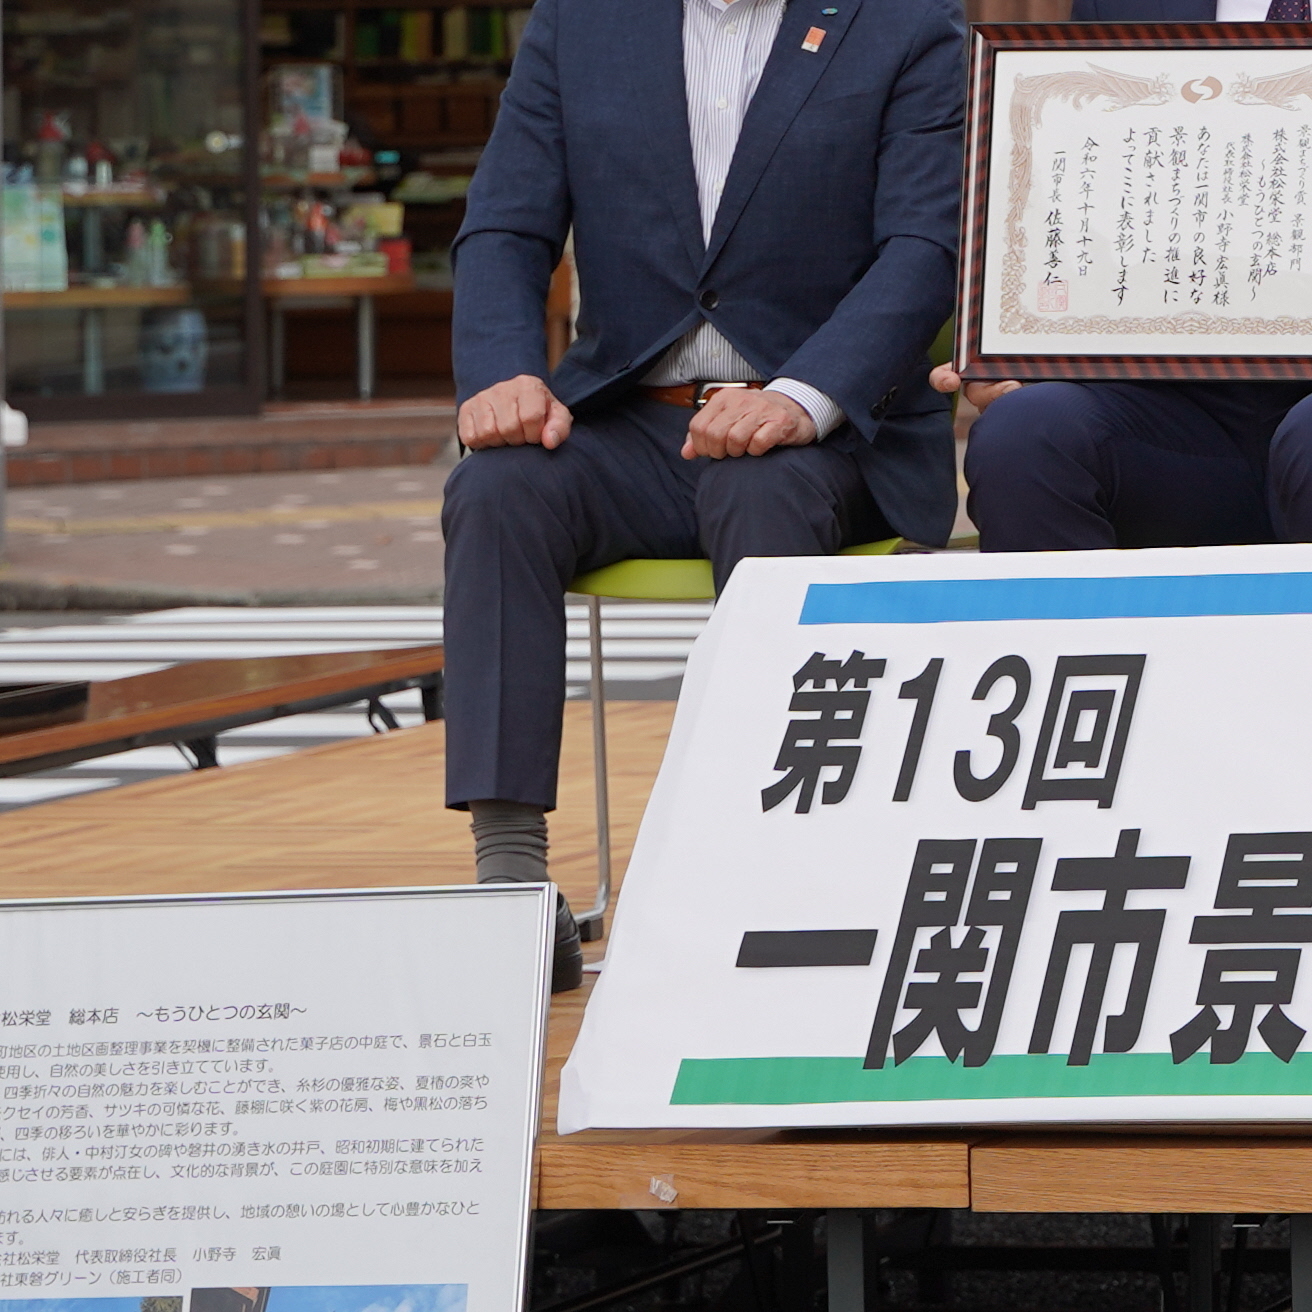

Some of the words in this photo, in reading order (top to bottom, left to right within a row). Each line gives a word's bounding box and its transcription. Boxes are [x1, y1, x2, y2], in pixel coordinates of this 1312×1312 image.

[1076, 136, 1098, 276] 令和六年十月十九日
[1111, 127, 1135, 305] よってここに表彰します
[1142, 127, 1163, 263] 貢献されました
[1164, 126, 1187, 303] 景観まちづくりの推進に
[759, 649, 1147, 814] 第13回
[2, 1009, 52, 1027] 松栄堂
[69, 1007, 119, 1026] 総本店
[0, 1096, 488, 1121] クセイの芳香、サツキの可憐な花、藤棚に咲く紫の花房、梅や黒松の落ち
[0, 1230, 24, 1246] す。
[0, 1249, 60, 1266] 社松栄堂
[76, 1247, 177, 1265] 代表取締役社長
[193, 1246, 237, 1262] 小野寺
